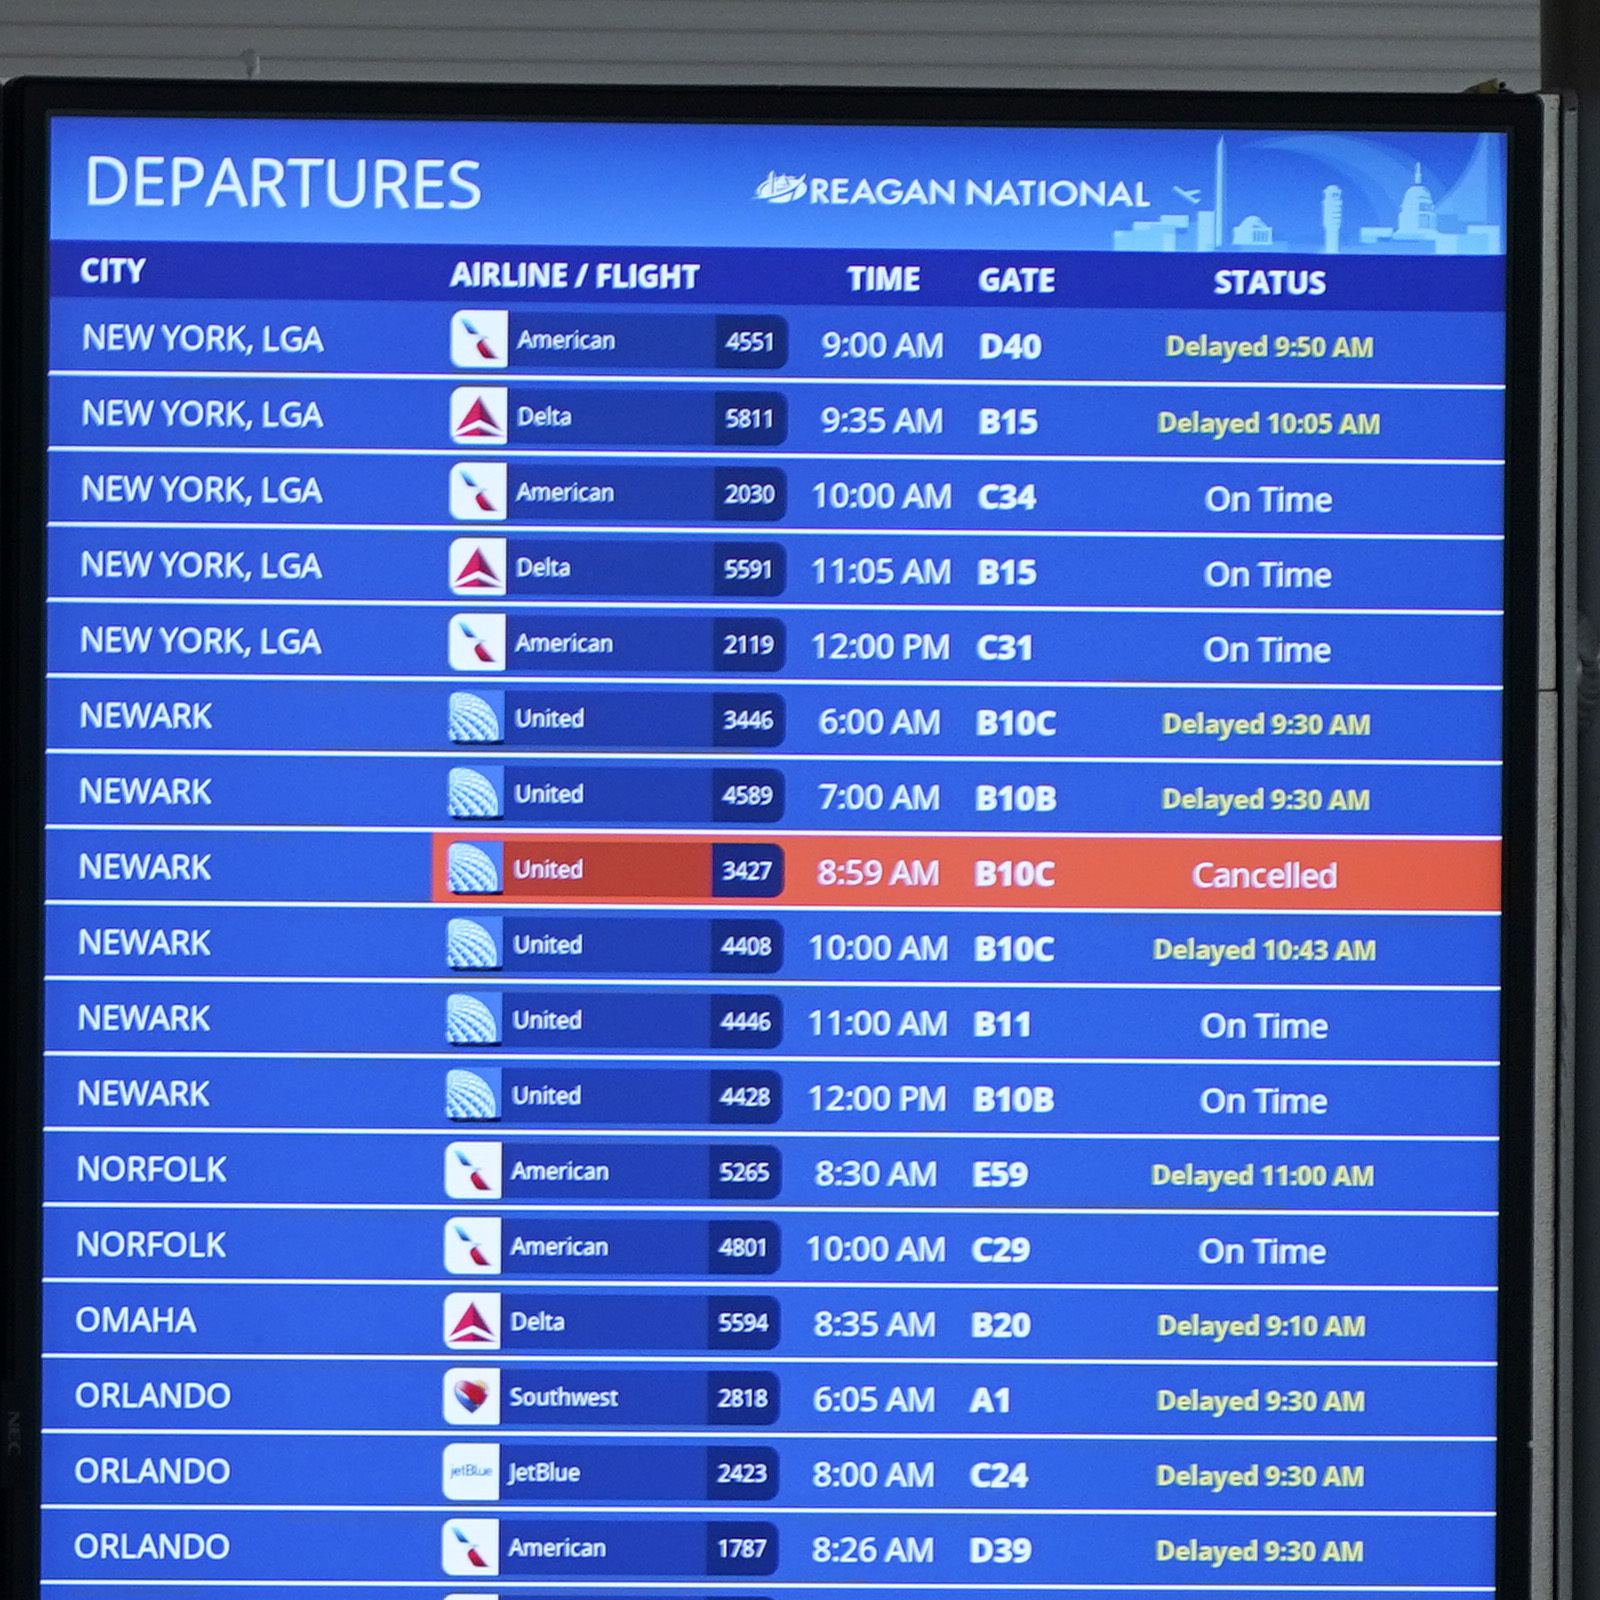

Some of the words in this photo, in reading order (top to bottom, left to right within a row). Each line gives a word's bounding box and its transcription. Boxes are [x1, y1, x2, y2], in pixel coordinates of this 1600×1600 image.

[87, 155, 481, 210] DEPARTURES
[810, 178, 956, 206] REAGAN
[965, 179, 1151, 208] NATIONAL
[80, 257, 147, 284] CITY
[449, 261, 568, 289] AIRLINE
[573, 262, 589, 289] /
[596, 263, 701, 290] FLIGHT
[846, 265, 921, 292] TIME
[978, 267, 1056, 293] GATE
[1213, 269, 1327, 296] STATUS
[82, 399, 155, 427] NEW
[160, 399, 253, 432] YORK,
[262, 401, 324, 429] LGA
[517, 405, 572, 427] Delta
[725, 408, 773, 429] 5811
[821, 406, 886, 434] 9:35
[892, 407, 943, 434] AM
[979, 408, 1039, 435] B15
[1157, 410, 1260, 441] Delayed
[1266, 412, 1333, 435] 10:05
[1337, 413, 1381, 435] AM
[79, 852, 212, 881] NEWARK
[514, 858, 584, 880] United
[722, 860, 773, 881] 3427
[817, 858, 883, 886] 8:59
[888, 859, 939, 886] AM
[975, 860, 1056, 887] B10C
[1192, 861, 1338, 889] Cancelled
[7, 1411, 21, 1456] NEC
